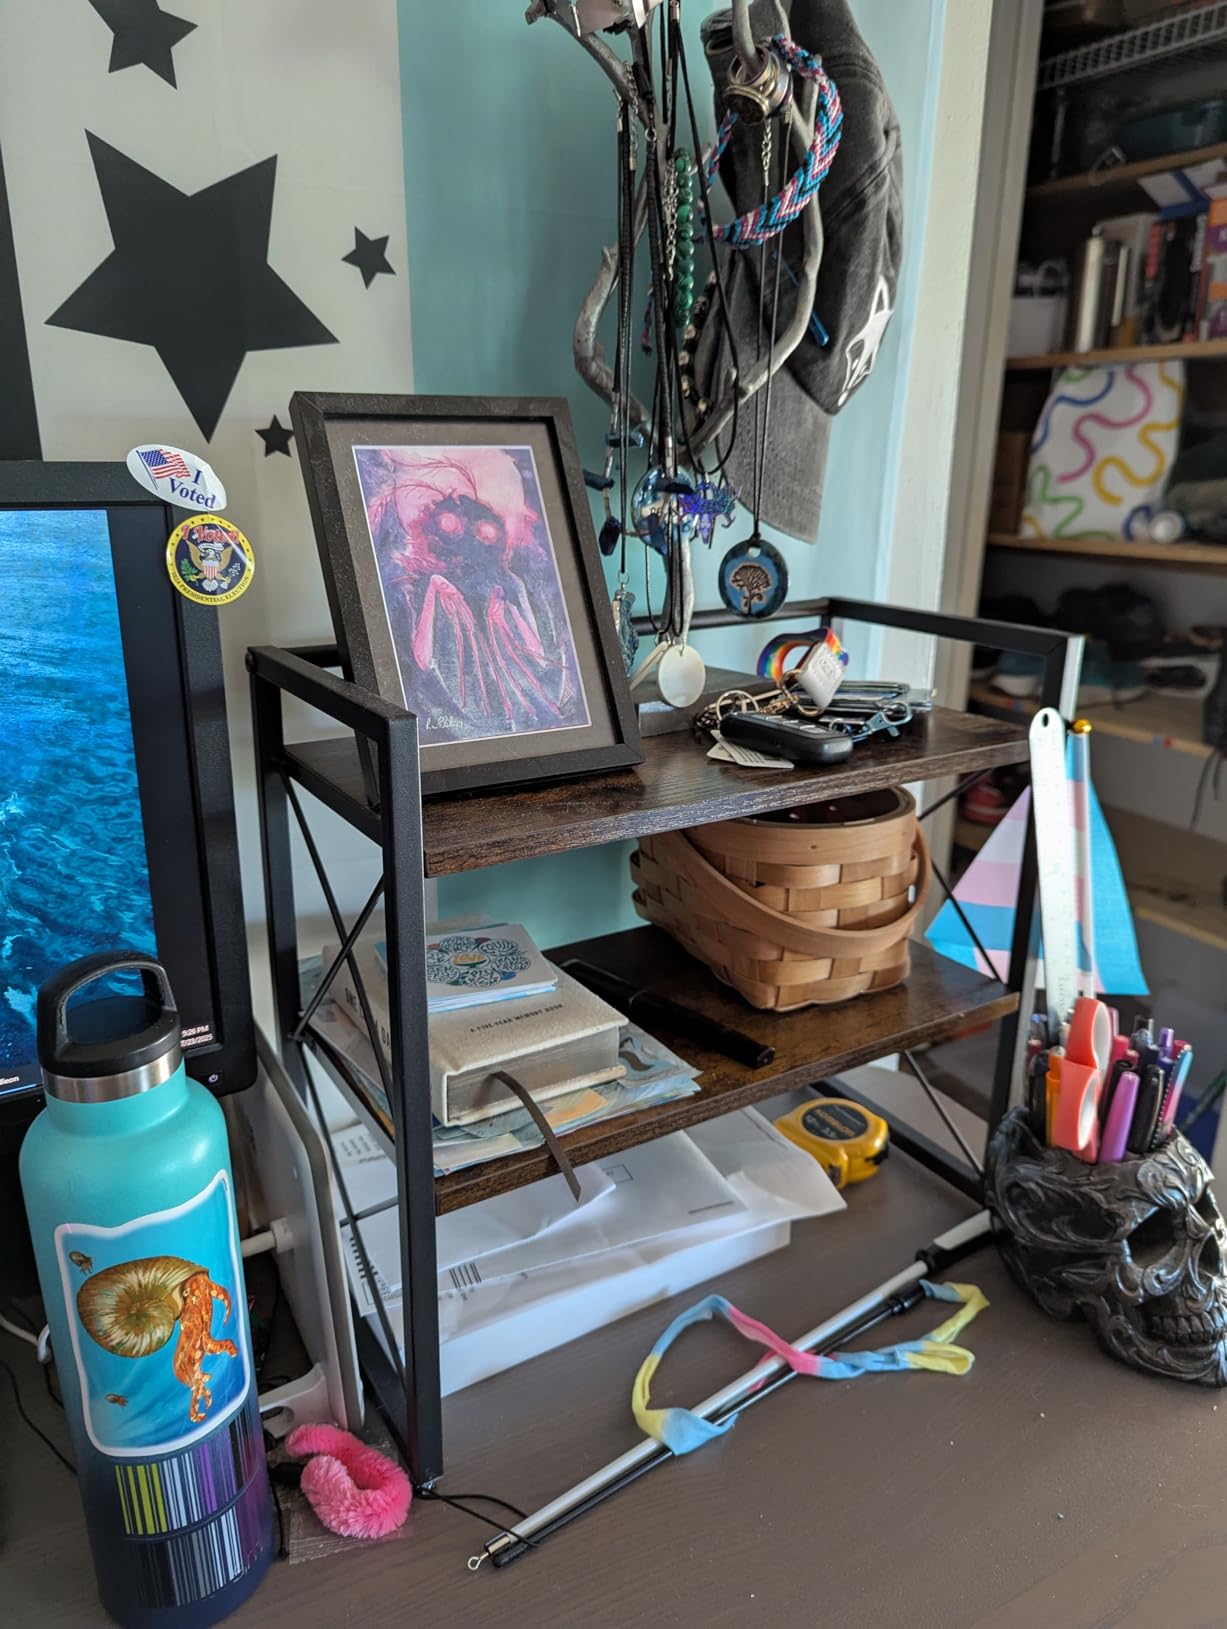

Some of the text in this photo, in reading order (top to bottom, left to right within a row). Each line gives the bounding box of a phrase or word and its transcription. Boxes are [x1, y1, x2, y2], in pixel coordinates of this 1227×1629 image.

[192, 468, 203, 485] I
[169, 477, 216, 509] Voted
[181, 524, 240, 545] I Voted
[179, 583, 225, 603] PRESIDENTIAL
[224, 575, 250, 600] ELECTION
